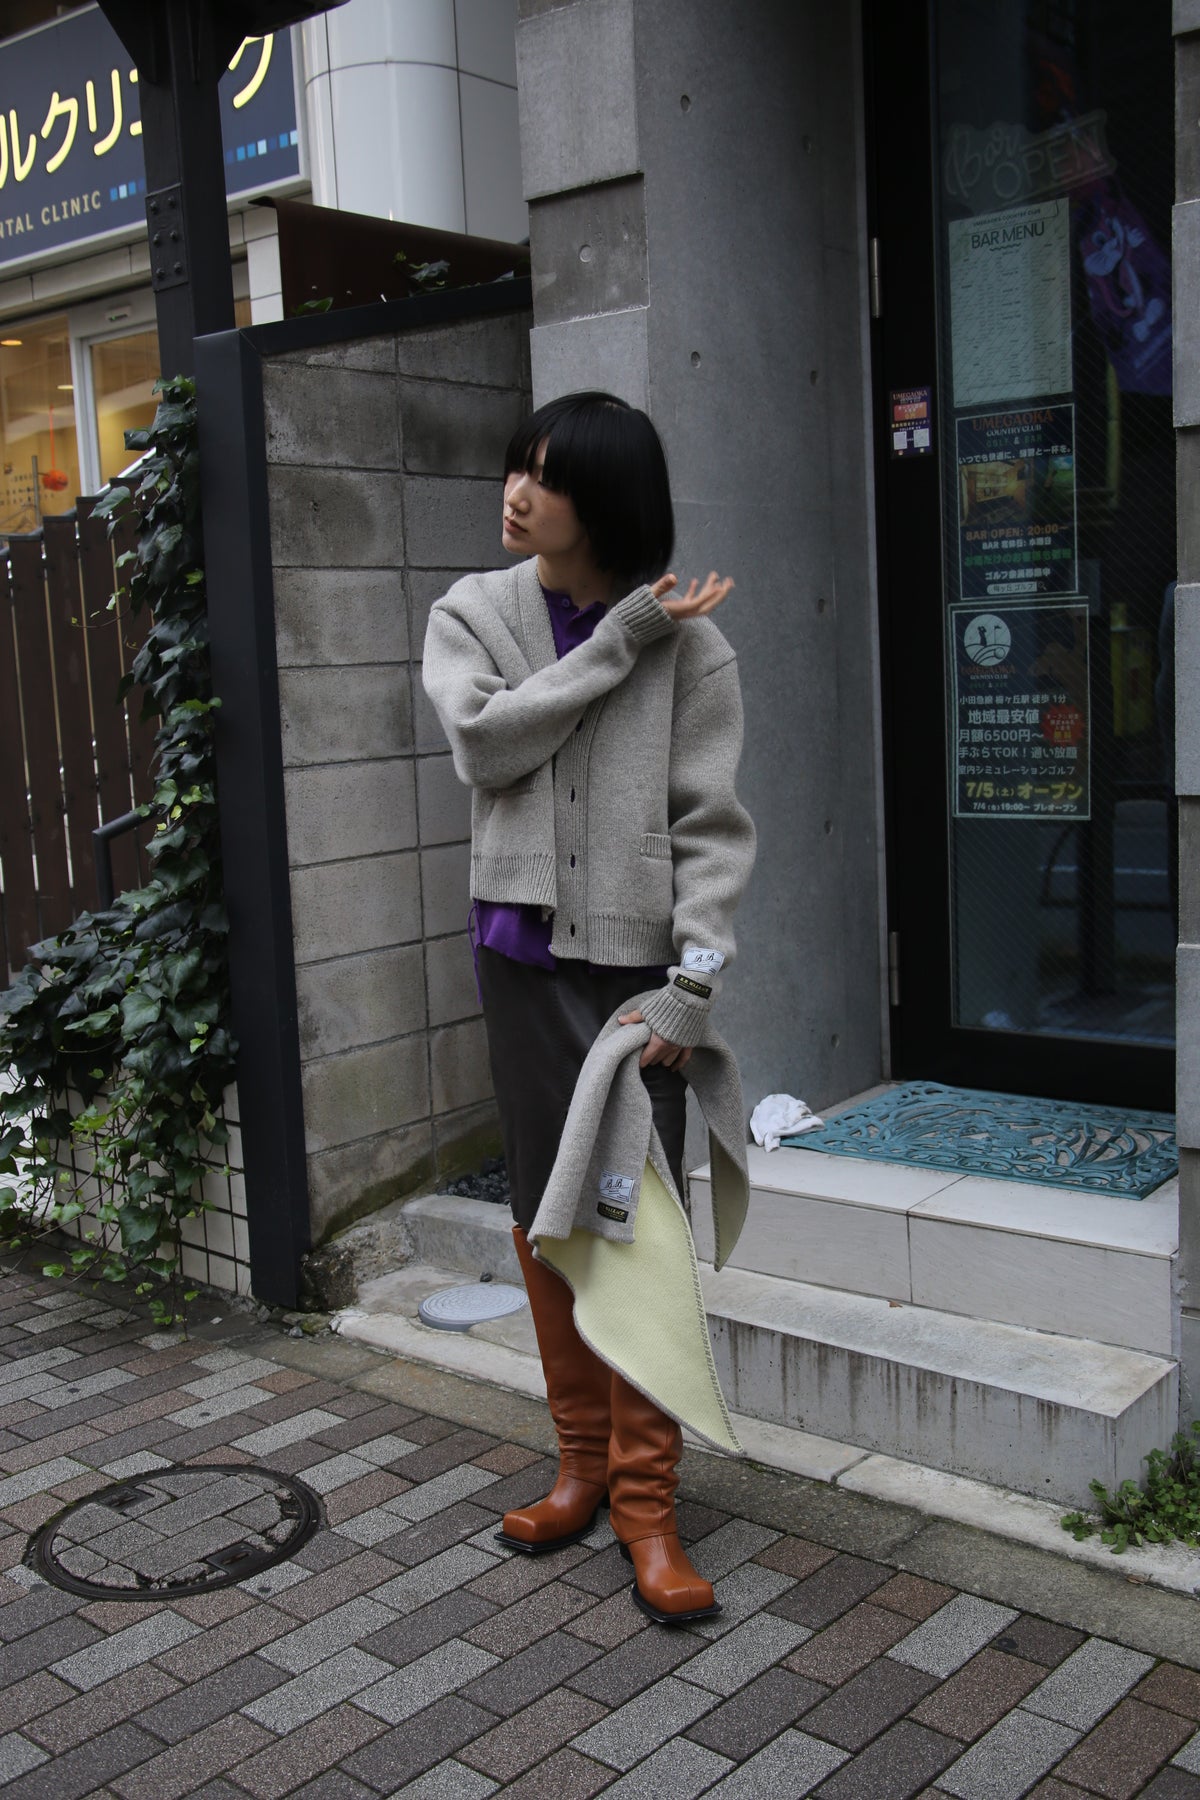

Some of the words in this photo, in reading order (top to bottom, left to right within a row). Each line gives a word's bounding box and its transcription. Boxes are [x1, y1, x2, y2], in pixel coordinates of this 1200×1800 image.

[945, 128, 1020, 199] Bar
[993, 126, 1103, 199] OPEN
[41, 190, 101, 226] CLINIC
[971, 230, 1000, 250] BAR
[1001, 220, 1045, 243] MENU
[972, 409, 1054, 431] UMEGAOKA
[986, 427, 1021, 437] COUNTRY
[1021, 424, 1042, 433] CLUB
[966, 530, 988, 541] BAR
[990, 527, 1025, 539] OPEN:
[982, 541, 1000, 550] BAR
[968, 708, 1040, 725] 地域最安値
